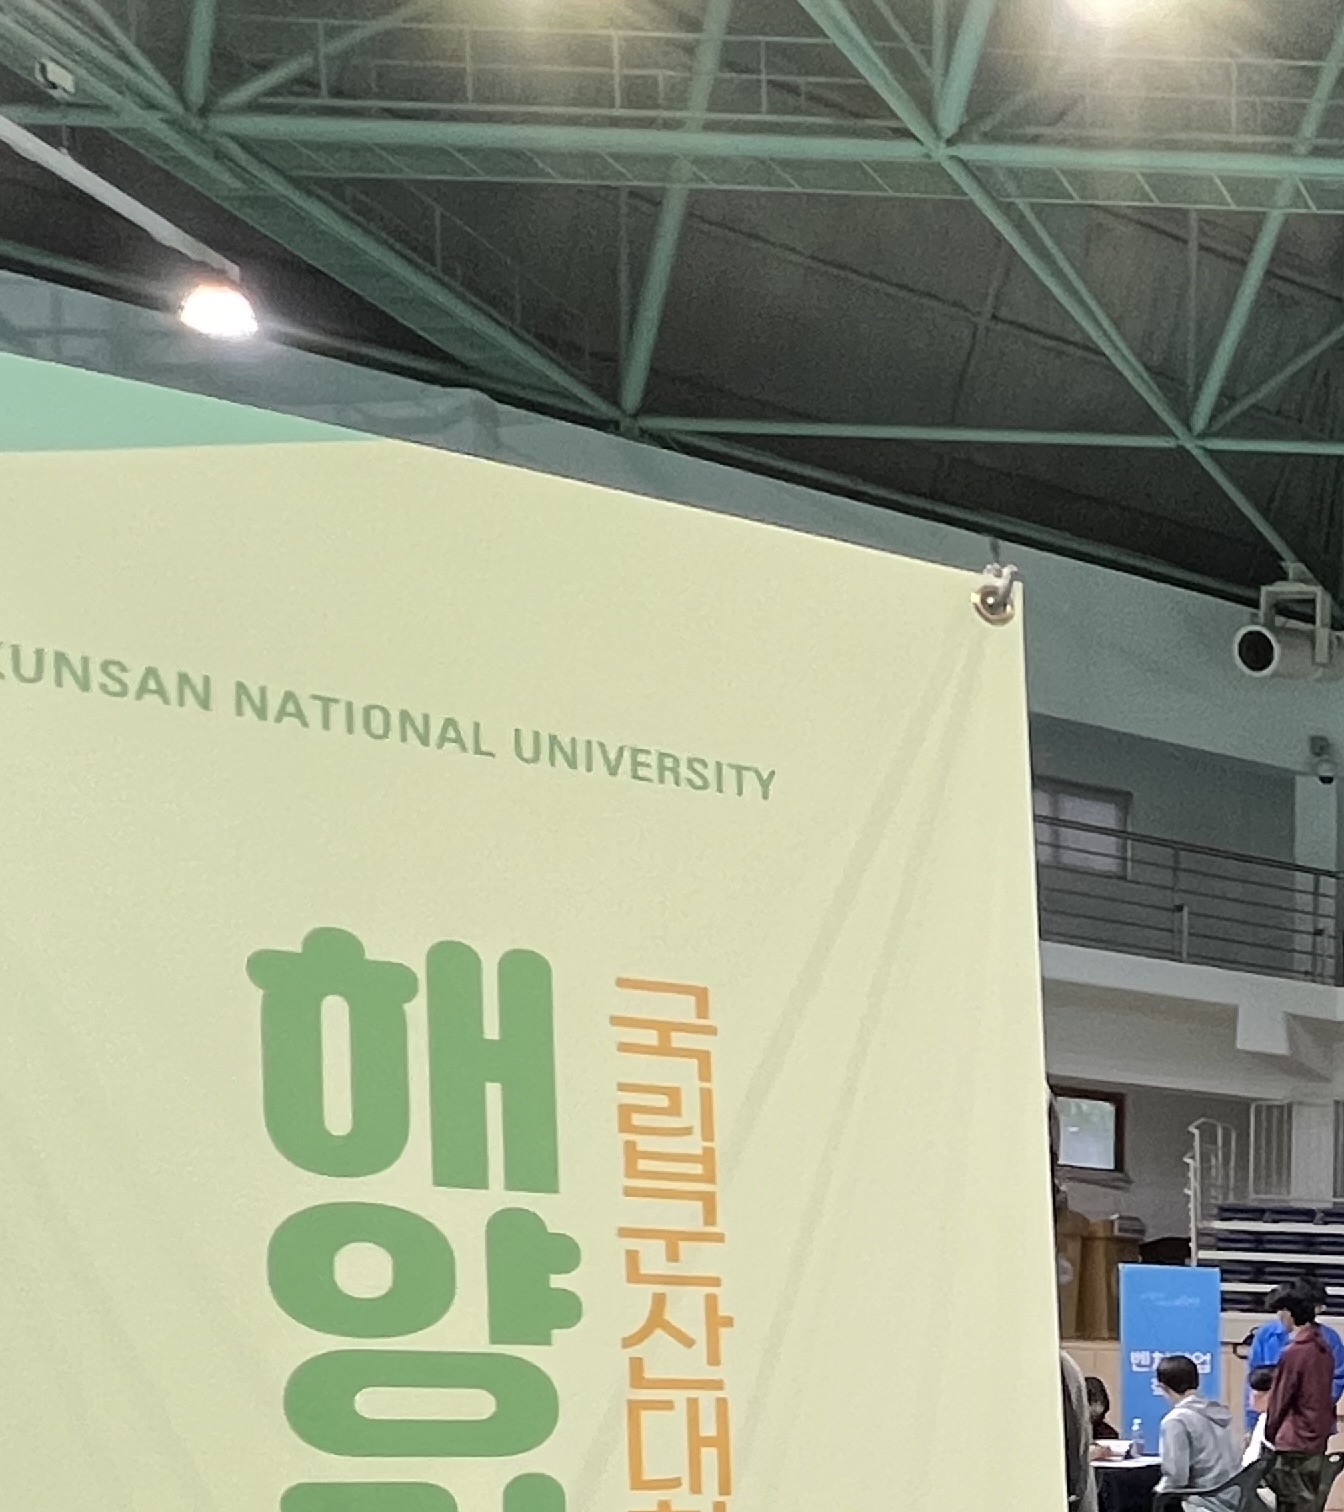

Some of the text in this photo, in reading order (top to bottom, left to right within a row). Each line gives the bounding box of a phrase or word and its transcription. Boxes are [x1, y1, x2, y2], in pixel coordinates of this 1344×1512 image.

[0, 641, 778, 801] UNSAN NATIONAL UNIVERSITY
